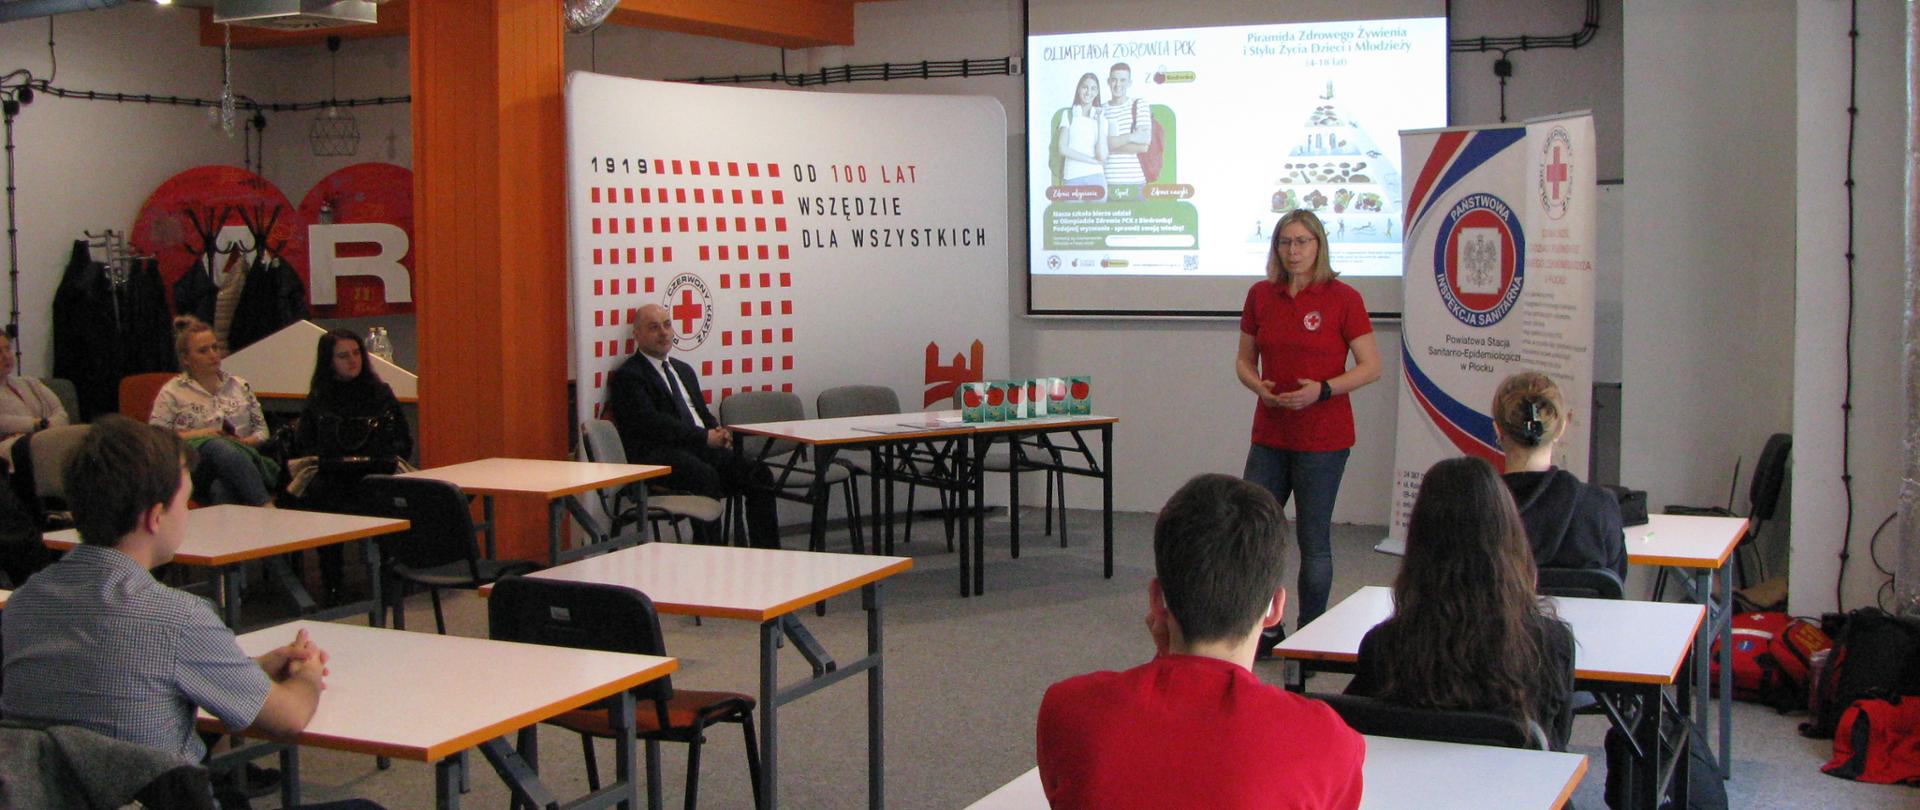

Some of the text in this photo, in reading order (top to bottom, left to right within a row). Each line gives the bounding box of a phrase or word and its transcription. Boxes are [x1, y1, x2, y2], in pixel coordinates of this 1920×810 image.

[1247, 25, 1407, 44] Piramida Zdrowego Żywienia
[1043, 39, 1196, 61] OLIMPIADA ZDROWIA PCK
[1249, 44, 1275, 59] Stylu
[1279, 41, 1308, 57] Życia
[1311, 42, 1345, 54] Dzieci
[590, 157, 649, 175] 1919
[793, 164, 918, 184] OD 100 LAT
[798, 197, 902, 221] WSZĘDZIE
[1450, 195, 1511, 222] PAŃSTWOWA
[802, 227, 987, 249] DLA WSZYSTKICH
[667, 275, 710, 299] CZERWONY
[1437, 273, 1523, 326] INSPEKCJA SANITARNA
[1446, 334, 1486, 346] Powiatowa
[1488, 336, 1511, 349] Stacja
